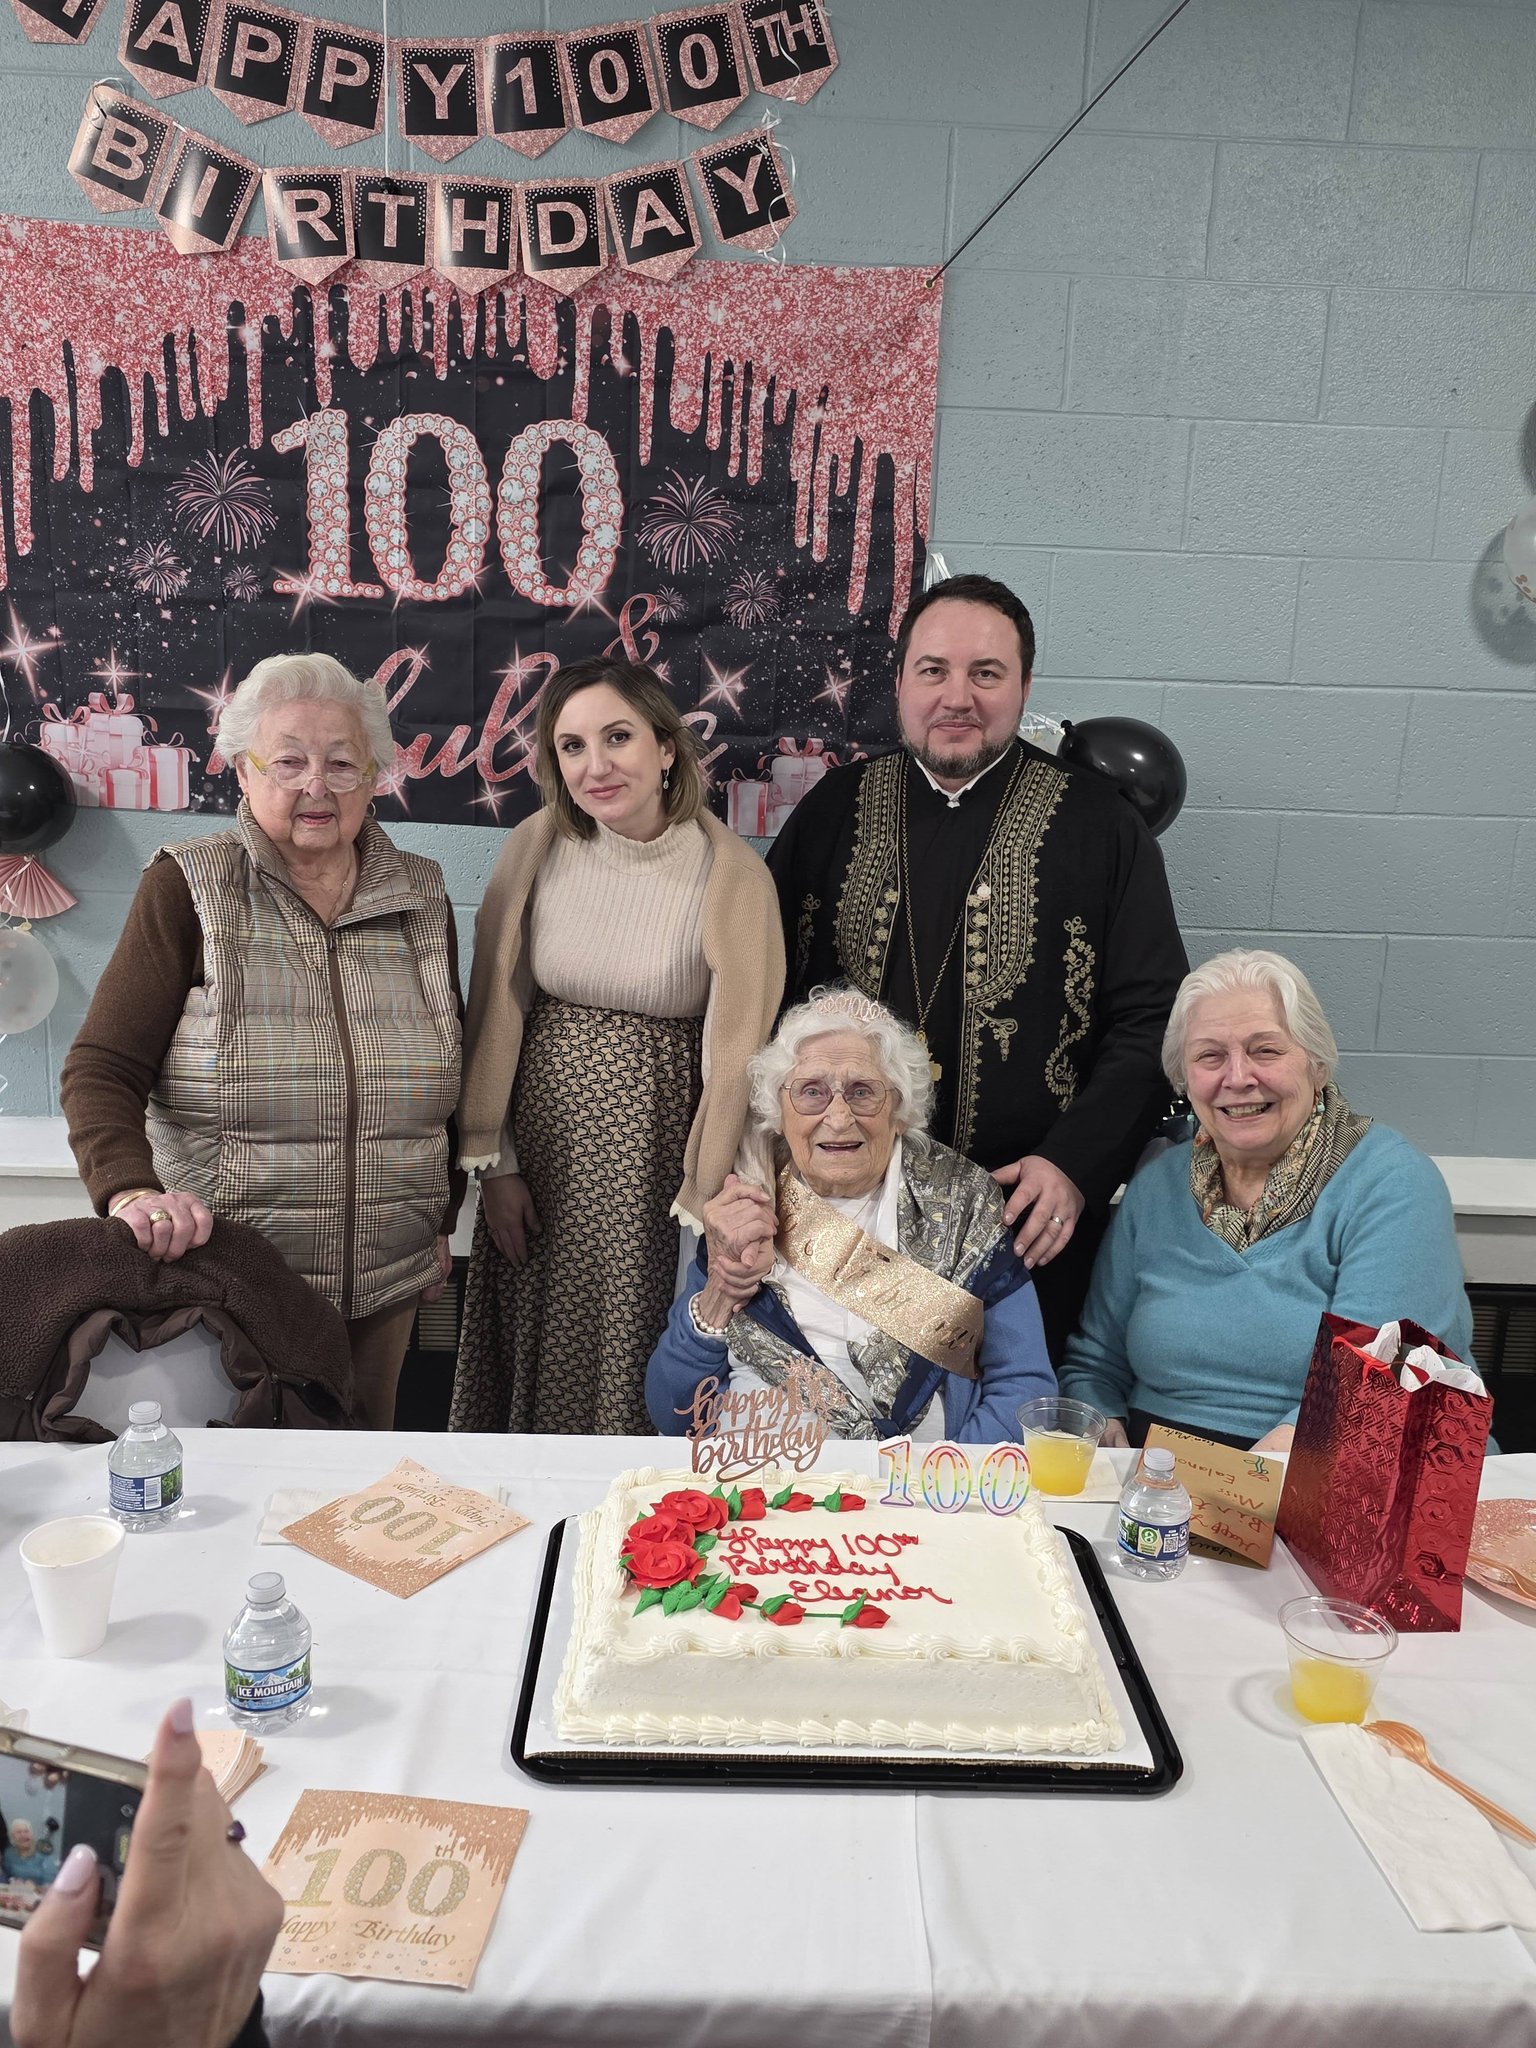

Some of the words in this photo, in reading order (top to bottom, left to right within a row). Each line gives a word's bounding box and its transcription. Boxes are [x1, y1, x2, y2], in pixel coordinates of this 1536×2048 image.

[62, 0, 468, 121] APPY
[90, 114, 768, 255] BIRTHDAY
[271, 408, 624, 606] 100
[879, 1438, 1032, 1516] 100
[393, 1482, 447, 1509] Birthday
[350, 1496, 473, 1556] 100
[450, 1504, 498, 1529] Happy
[717, 1526, 840, 1560] Happy
[719, 1554, 900, 1586] Birthday
[788, 1579, 953, 1604] Eleanor
[239, 1687, 253, 1698] ICE
[254, 1676, 303, 1697] MOUNTAIN
[283, 1848, 471, 1918] 100
[354, 1919, 456, 1954] Birthday
